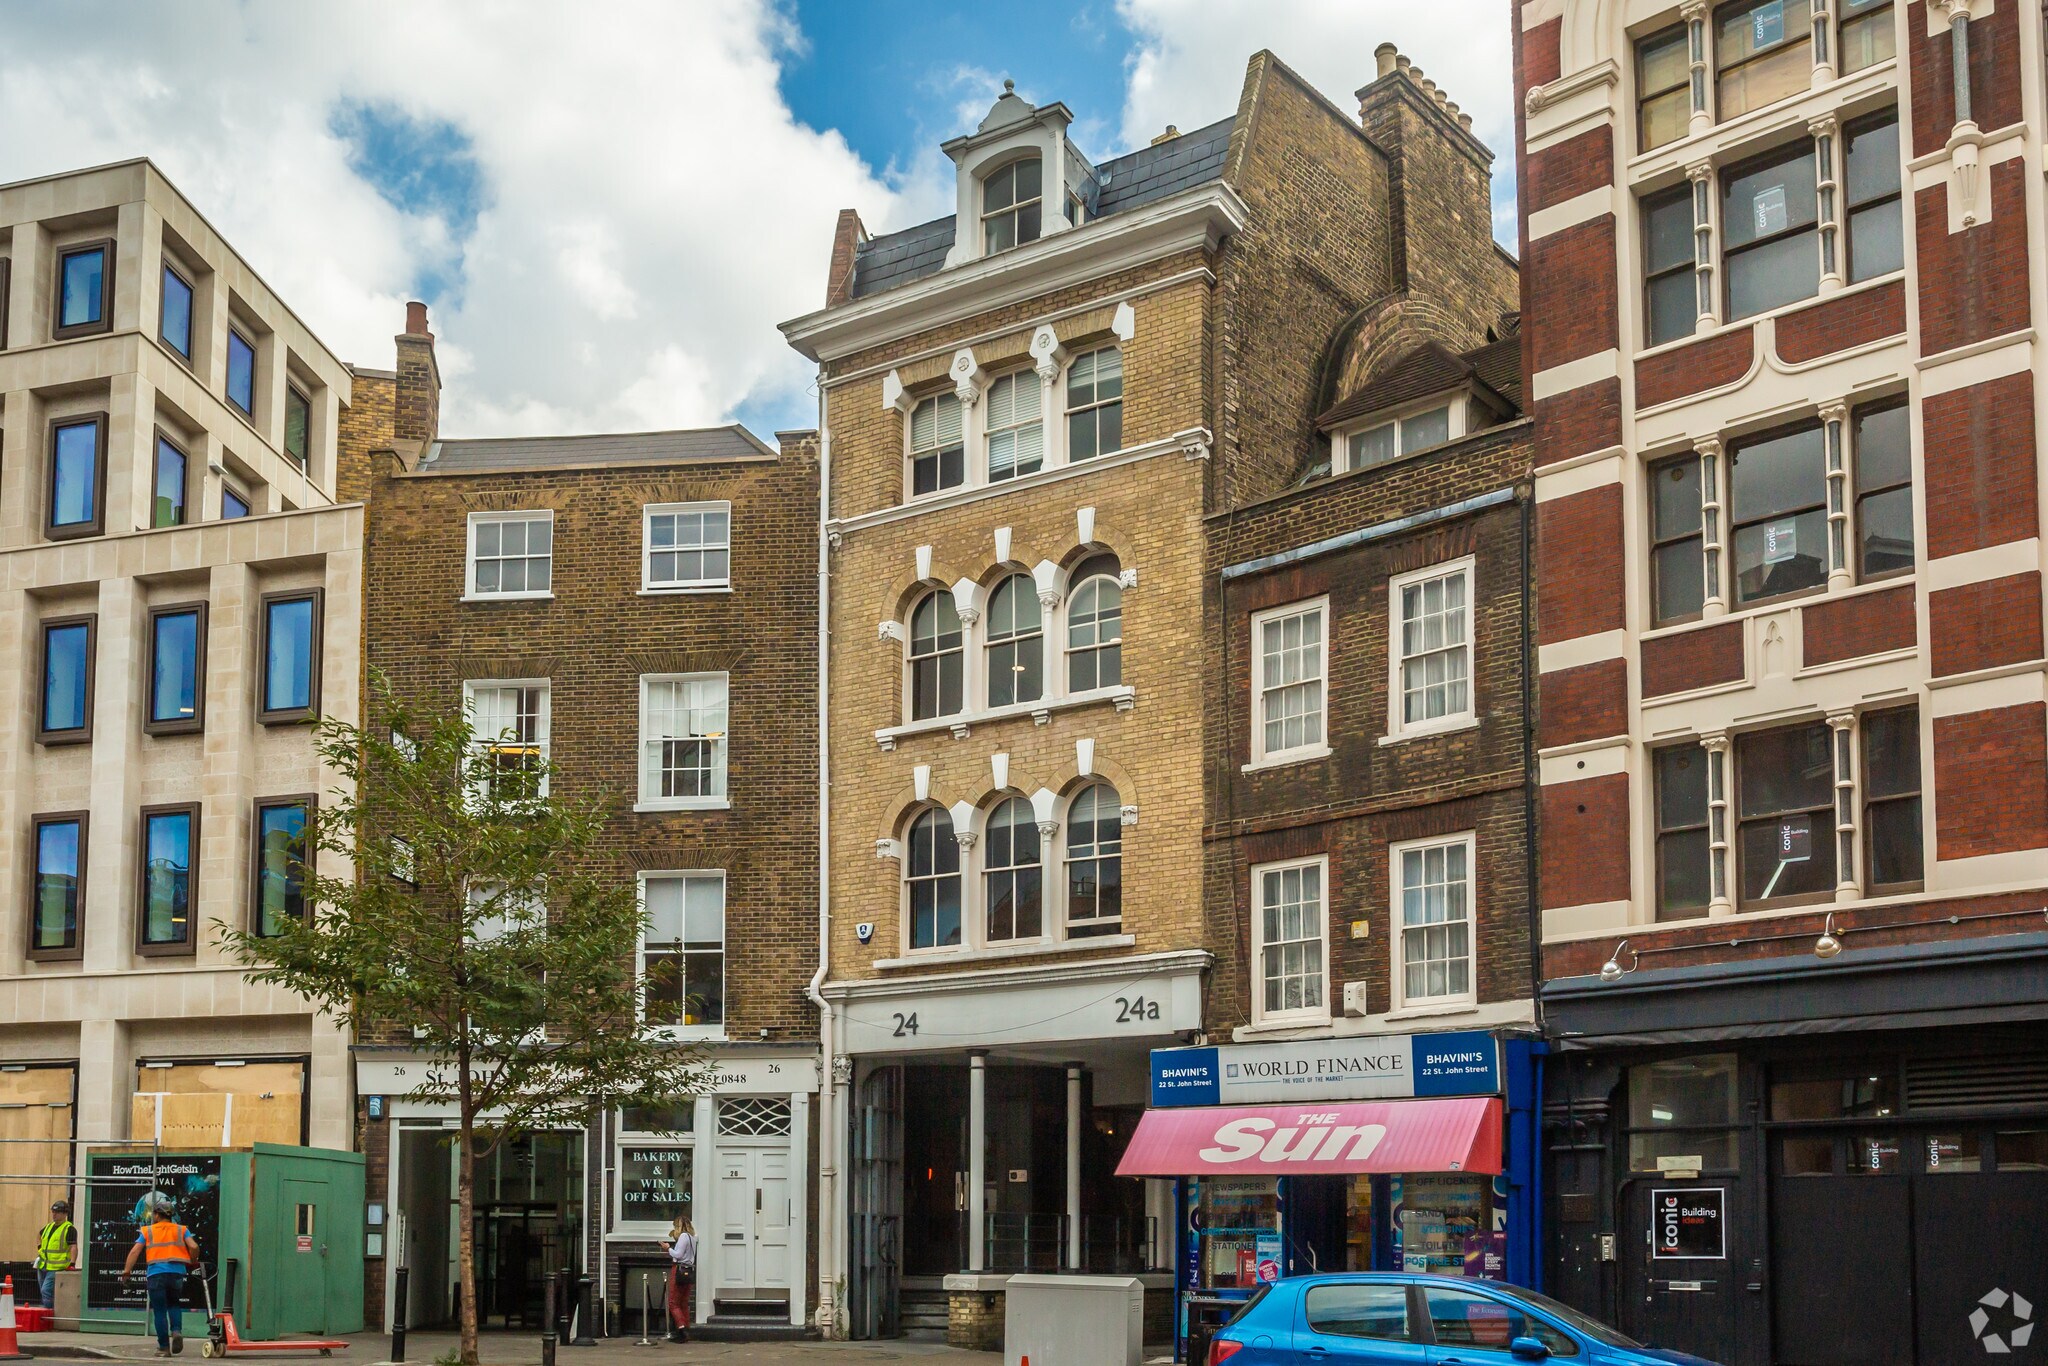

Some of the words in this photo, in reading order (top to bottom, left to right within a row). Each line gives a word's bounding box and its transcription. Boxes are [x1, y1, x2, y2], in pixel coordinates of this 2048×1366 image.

[1115, 996, 1160, 1023] 24a
[893, 1012, 919, 1037] 24
[1426, 1052, 1483, 1064] BHAVINI'S
[394, 1066, 406, 1076] 26
[767, 1064, 781, 1074] 26
[1243, 1060, 1309, 1077] WORLD
[1317, 1054, 1403, 1074] FINANCE
[1422, 1068, 1431, 1076] 22
[1433, 1067, 1444, 1075] St.
[1445, 1066, 1463, 1075] John
[1465, 1065, 1488, 1074] Street
[1162, 1067, 1208, 1078] BHAVINI'S
[721, 1073, 747, 1084] 0848
[1193, 1079, 1212, 1087] Street
[1297, 1112, 1341, 1125] THE
[1199, 1117, 1387, 1163] Sun
[633, 1152, 683, 1162] BAKERY
[113, 1164, 198, 1175] HowTheLghtGetsIn
[653, 1165, 662, 1175] &
[641, 1179, 675, 1189] WINE
[1416, 1177, 1435, 1186] OFF
[1437, 1176, 1480, 1186] LICENCE
[624, 1192, 648, 1202] OFF
[652, 1192, 691, 1202] SALES
[1681, 1207, 1717, 1218] Building
[1660, 1197, 1678, 1252] iconic
